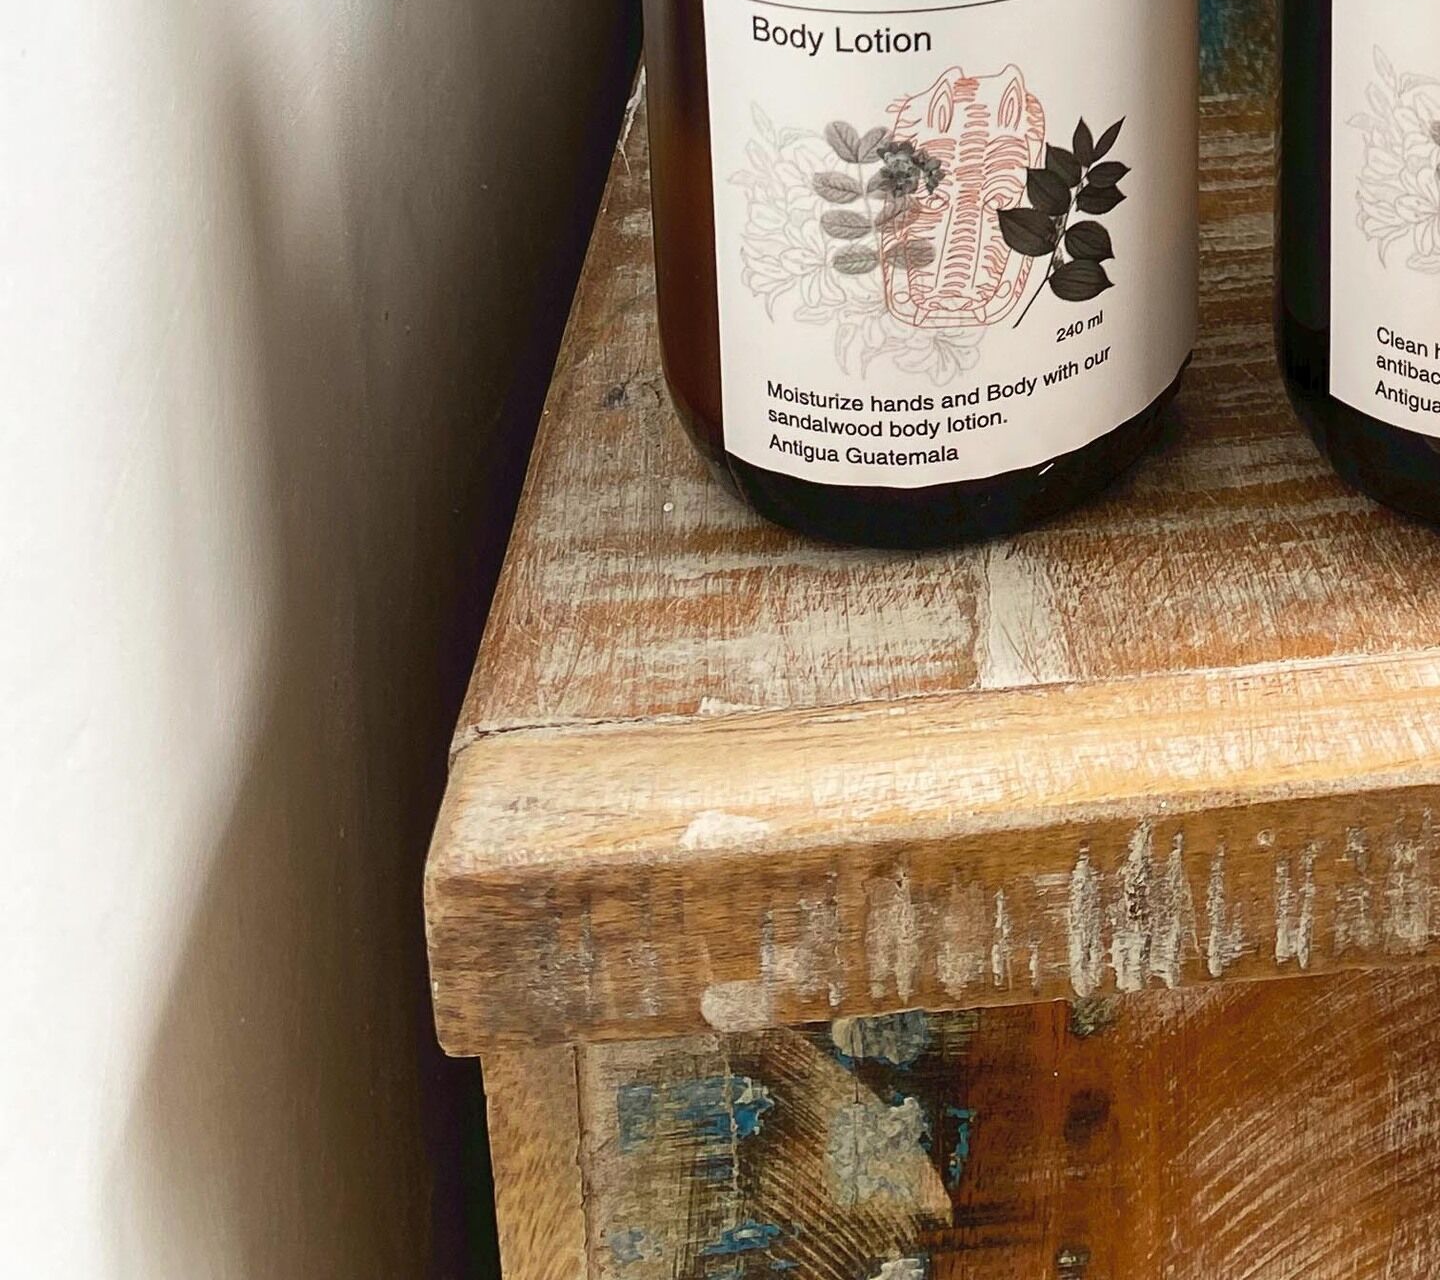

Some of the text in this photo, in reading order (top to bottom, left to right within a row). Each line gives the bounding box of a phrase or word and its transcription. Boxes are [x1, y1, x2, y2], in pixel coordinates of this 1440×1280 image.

[752, 15, 932, 57] Body Lotion
[1055, 309, 1104, 343] 240 ml
[1376, 326, 1429, 358] Clean
[767, 346, 1111, 413] Moisturize hands and Body with our
[768, 408, 1008, 440] sandalwood body lotion.
[768, 433, 960, 466] Antigua Guatemala
